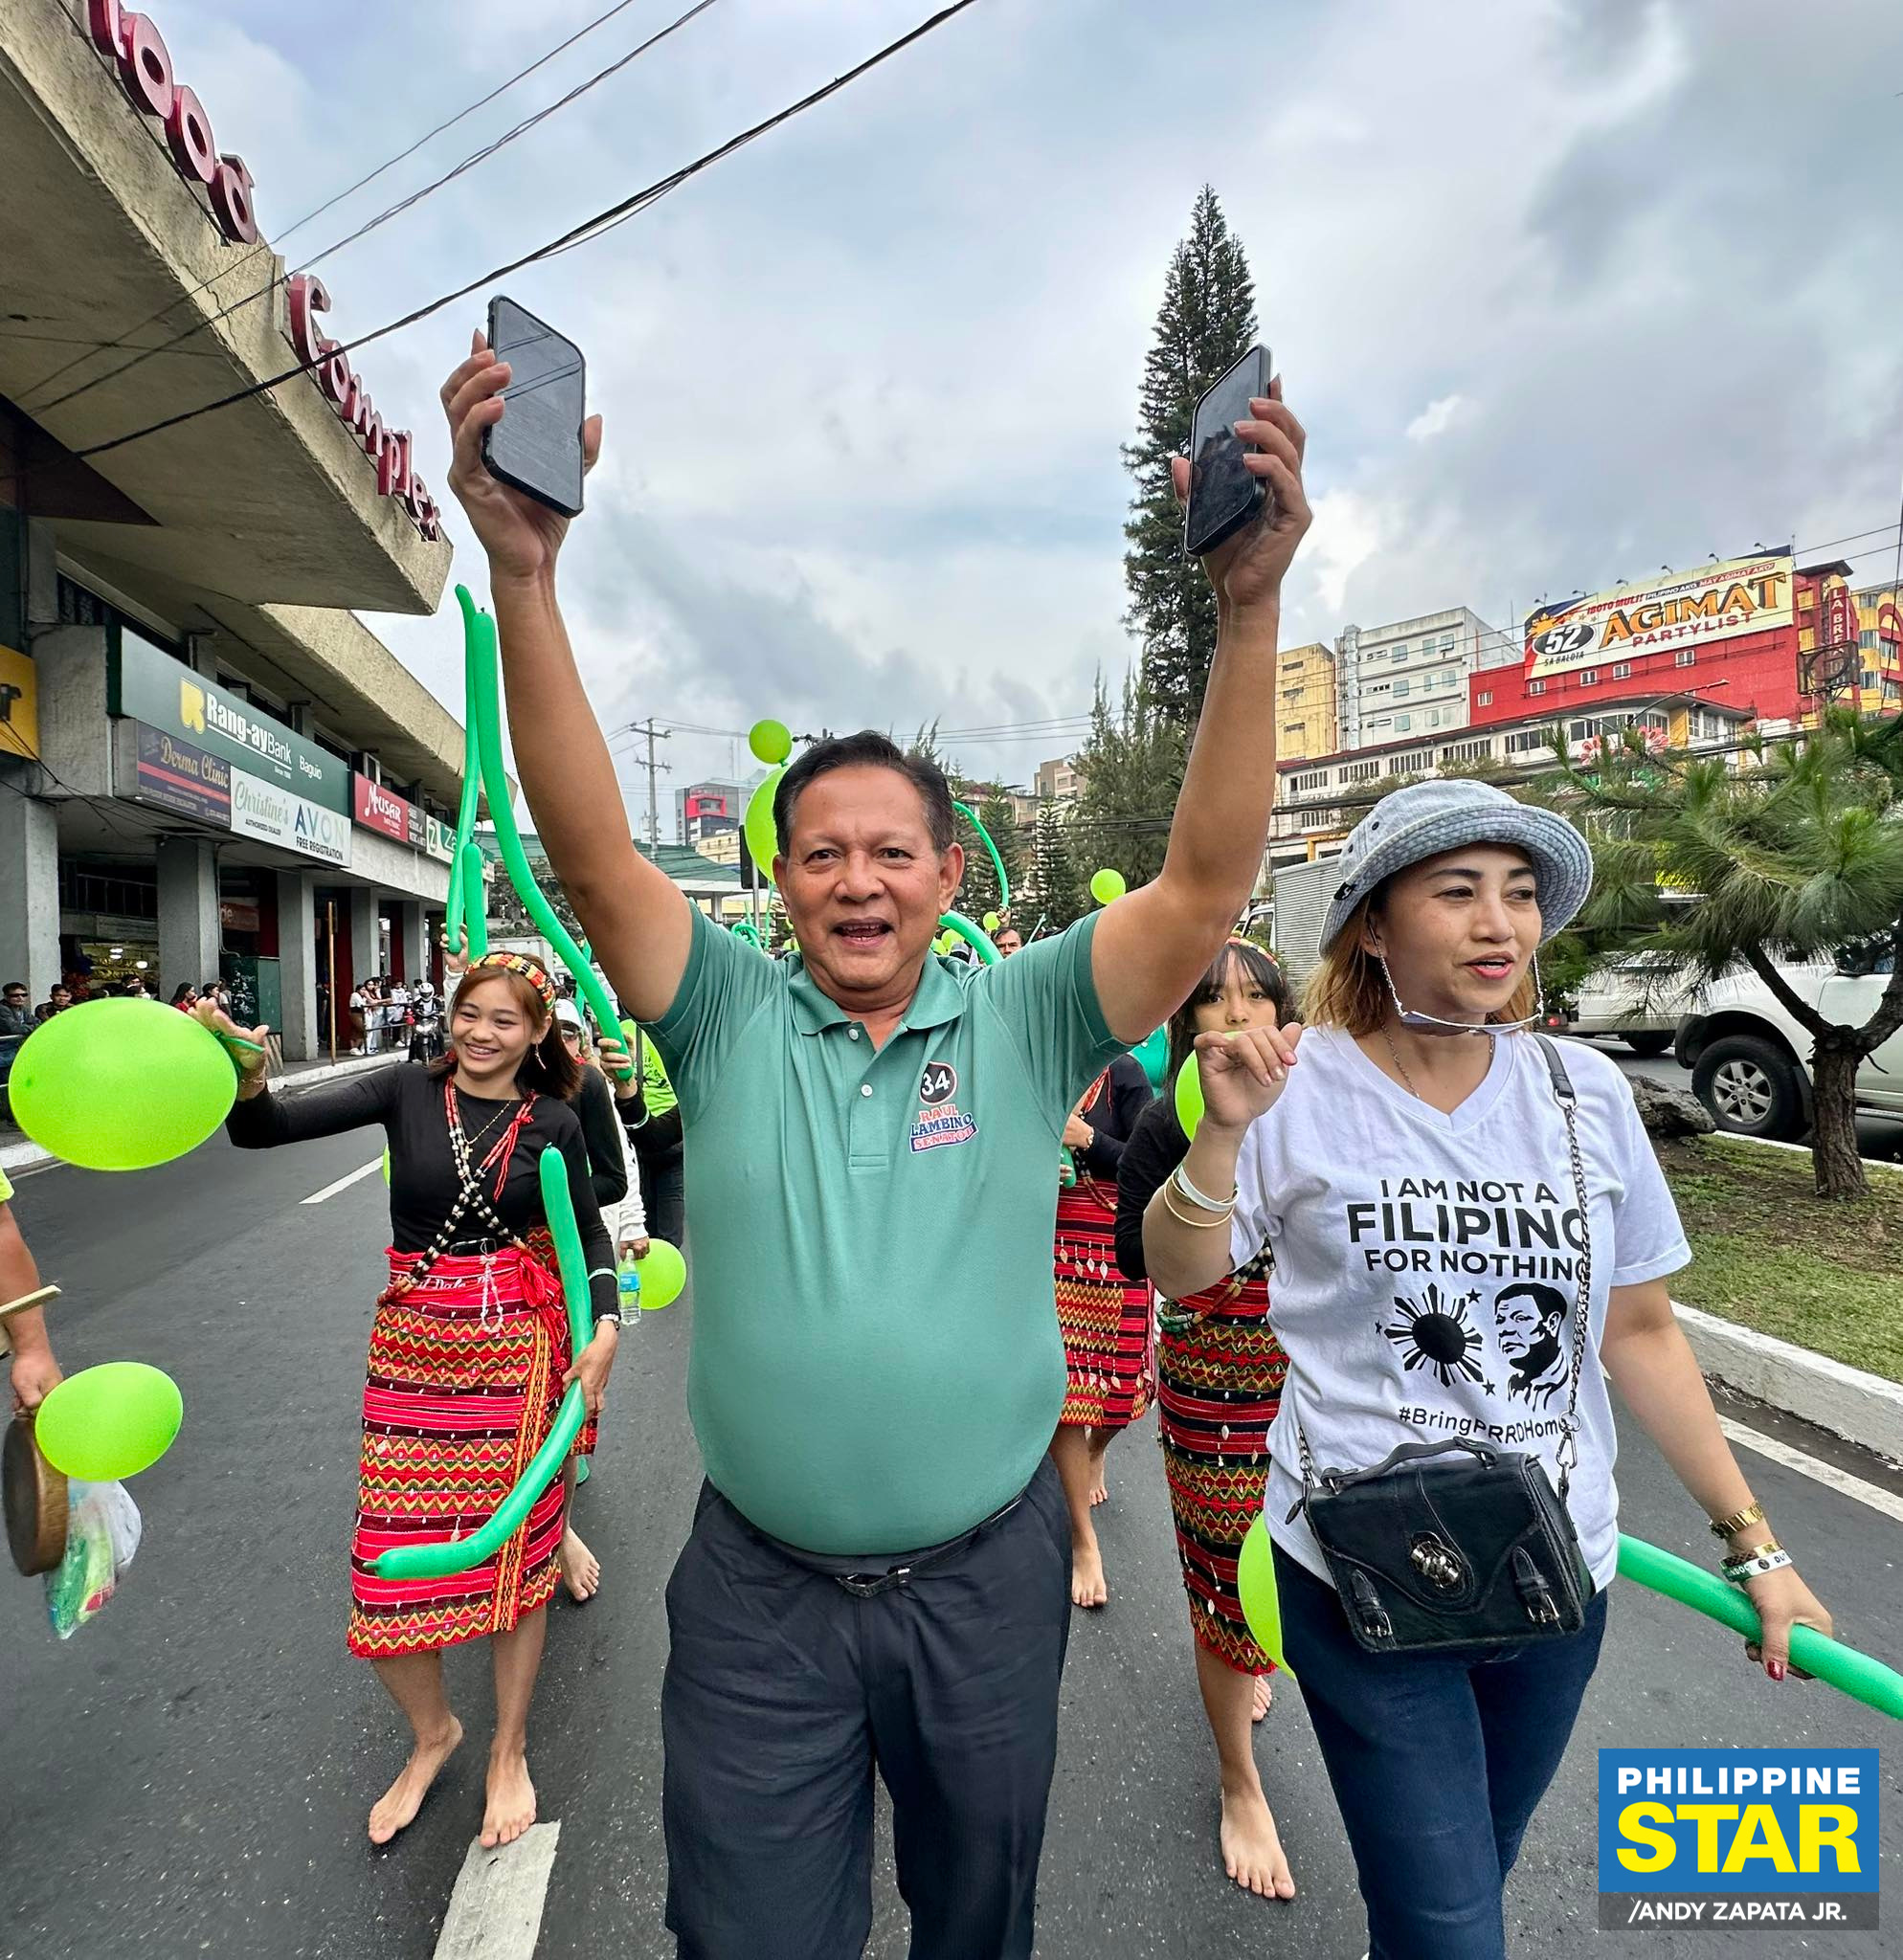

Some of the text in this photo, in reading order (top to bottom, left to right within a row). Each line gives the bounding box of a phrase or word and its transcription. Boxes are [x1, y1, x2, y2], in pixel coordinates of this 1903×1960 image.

[289, 271, 441, 542] Complex
[1599, 572, 1786, 650] AGIMAT
[1832, 589, 1844, 610] LA
[1544, 624, 1582, 655] 52
[1632, 611, 1755, 648] PARTYLIST
[1544, 657, 1556, 667] SA
[161, 736, 198, 776] Derma
[201, 754, 230, 790] Clinic
[300, 754, 323, 780] Baguio
[235, 781, 289, 825] Christine's
[295, 804, 346, 848] AVON
[297, 835, 344, 860] FREE REGISTRATION
[921, 1070, 951, 1096] 34
[911, 1114, 973, 1136] LAMBINO
[920, 1104, 958, 1123] RAUL
[1381, 1178, 1559, 1204] I AM NOT A
[1364, 1248, 1433, 1273] FOR
